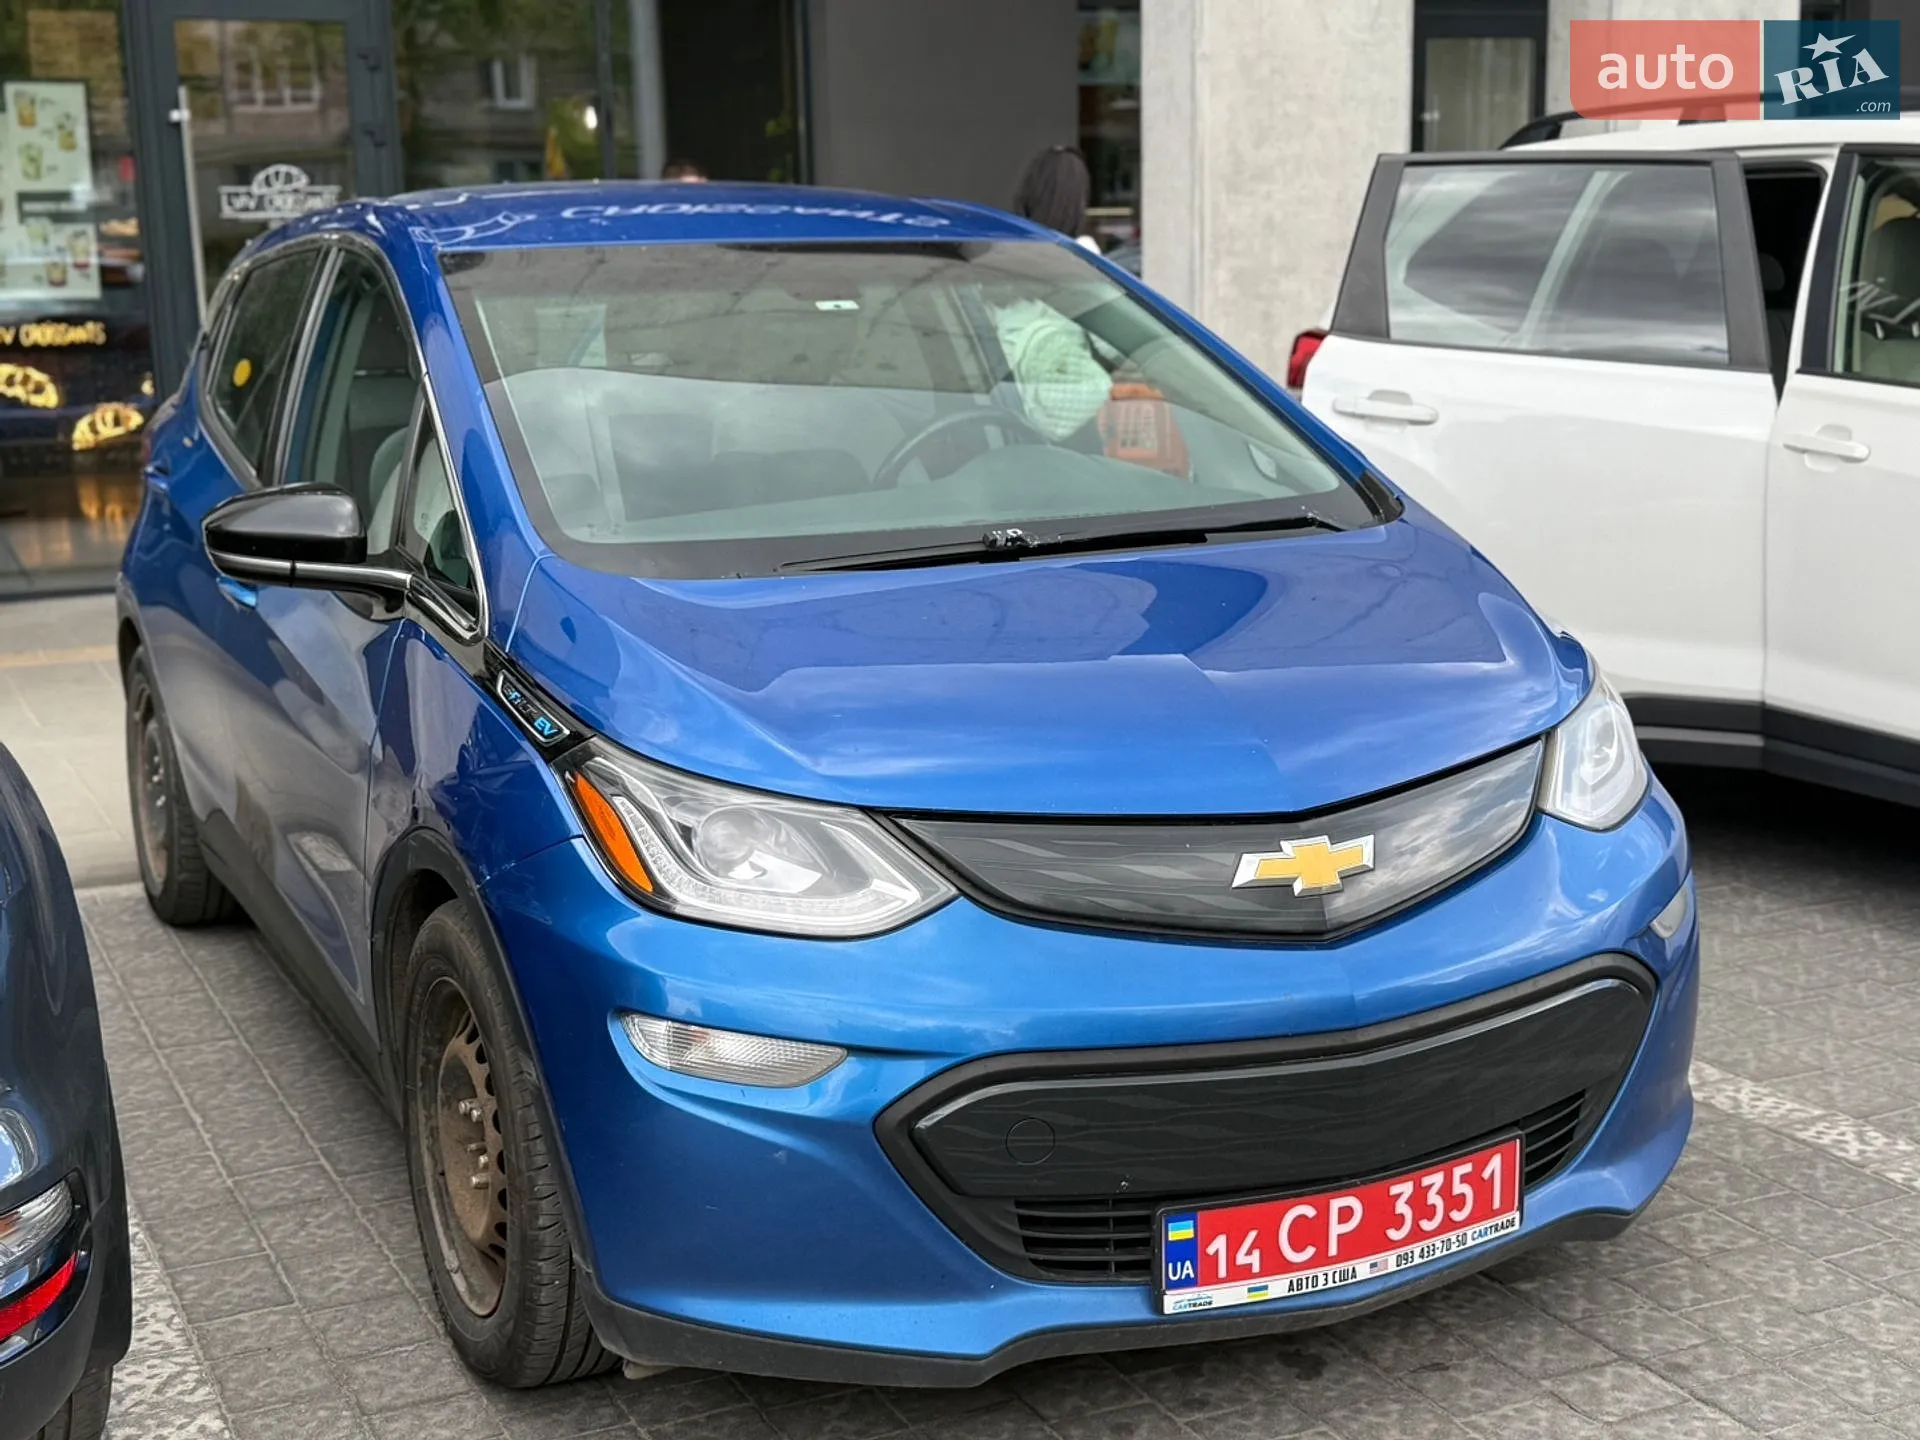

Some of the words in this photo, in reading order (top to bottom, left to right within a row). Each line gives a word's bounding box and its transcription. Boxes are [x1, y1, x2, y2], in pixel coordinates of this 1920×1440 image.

[534, 716, 559, 736] EV
[1205, 1229, 1261, 1279] 14
[1277, 1195, 1364, 1264] CP
[1385, 1152, 1502, 1241] 3351
[1396, 1250, 1415, 1268] 093
[1418, 1232, 1468, 1261] 433-70-50
[1471, 1216, 1516, 1242] CARTRADE
[1168, 1259, 1195, 1281] UA
[1287, 1274, 1319, 1294] АВТО
[1332, 1266, 1358, 1284] США
